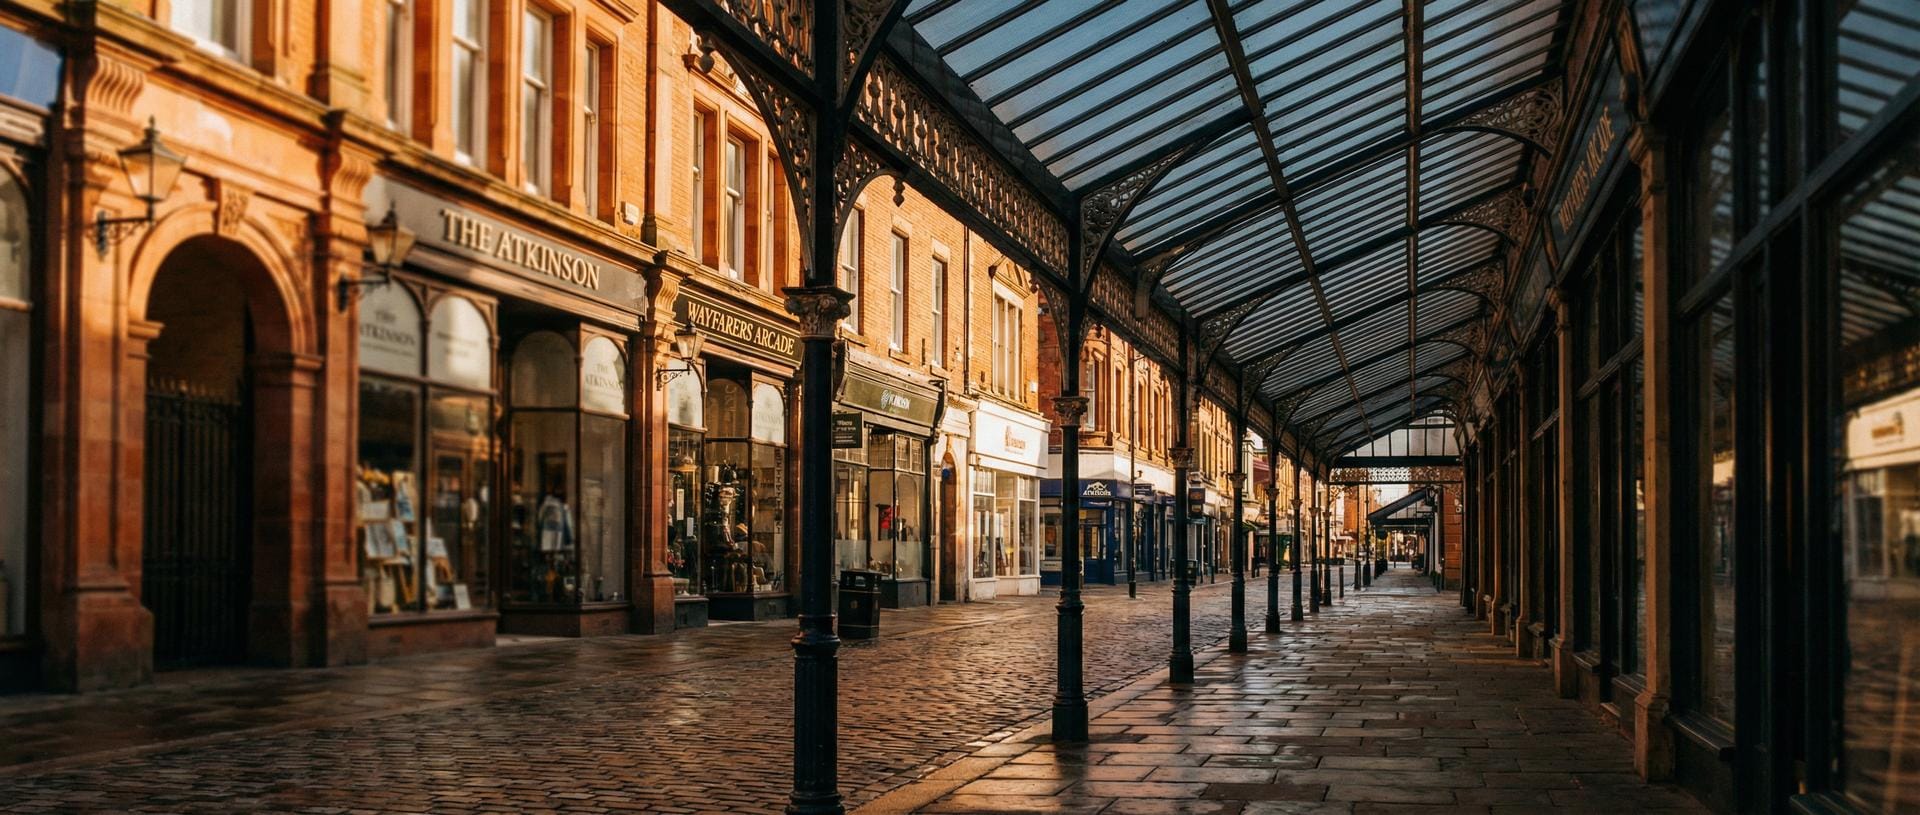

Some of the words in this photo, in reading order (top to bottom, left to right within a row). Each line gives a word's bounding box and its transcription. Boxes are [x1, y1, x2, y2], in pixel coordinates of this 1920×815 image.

[441, 208, 493, 250] THE
[496, 231, 601, 291] ATKINSON
[687, 301, 754, 342] WAYFARERS
[753, 326, 795, 355] ARCADE
